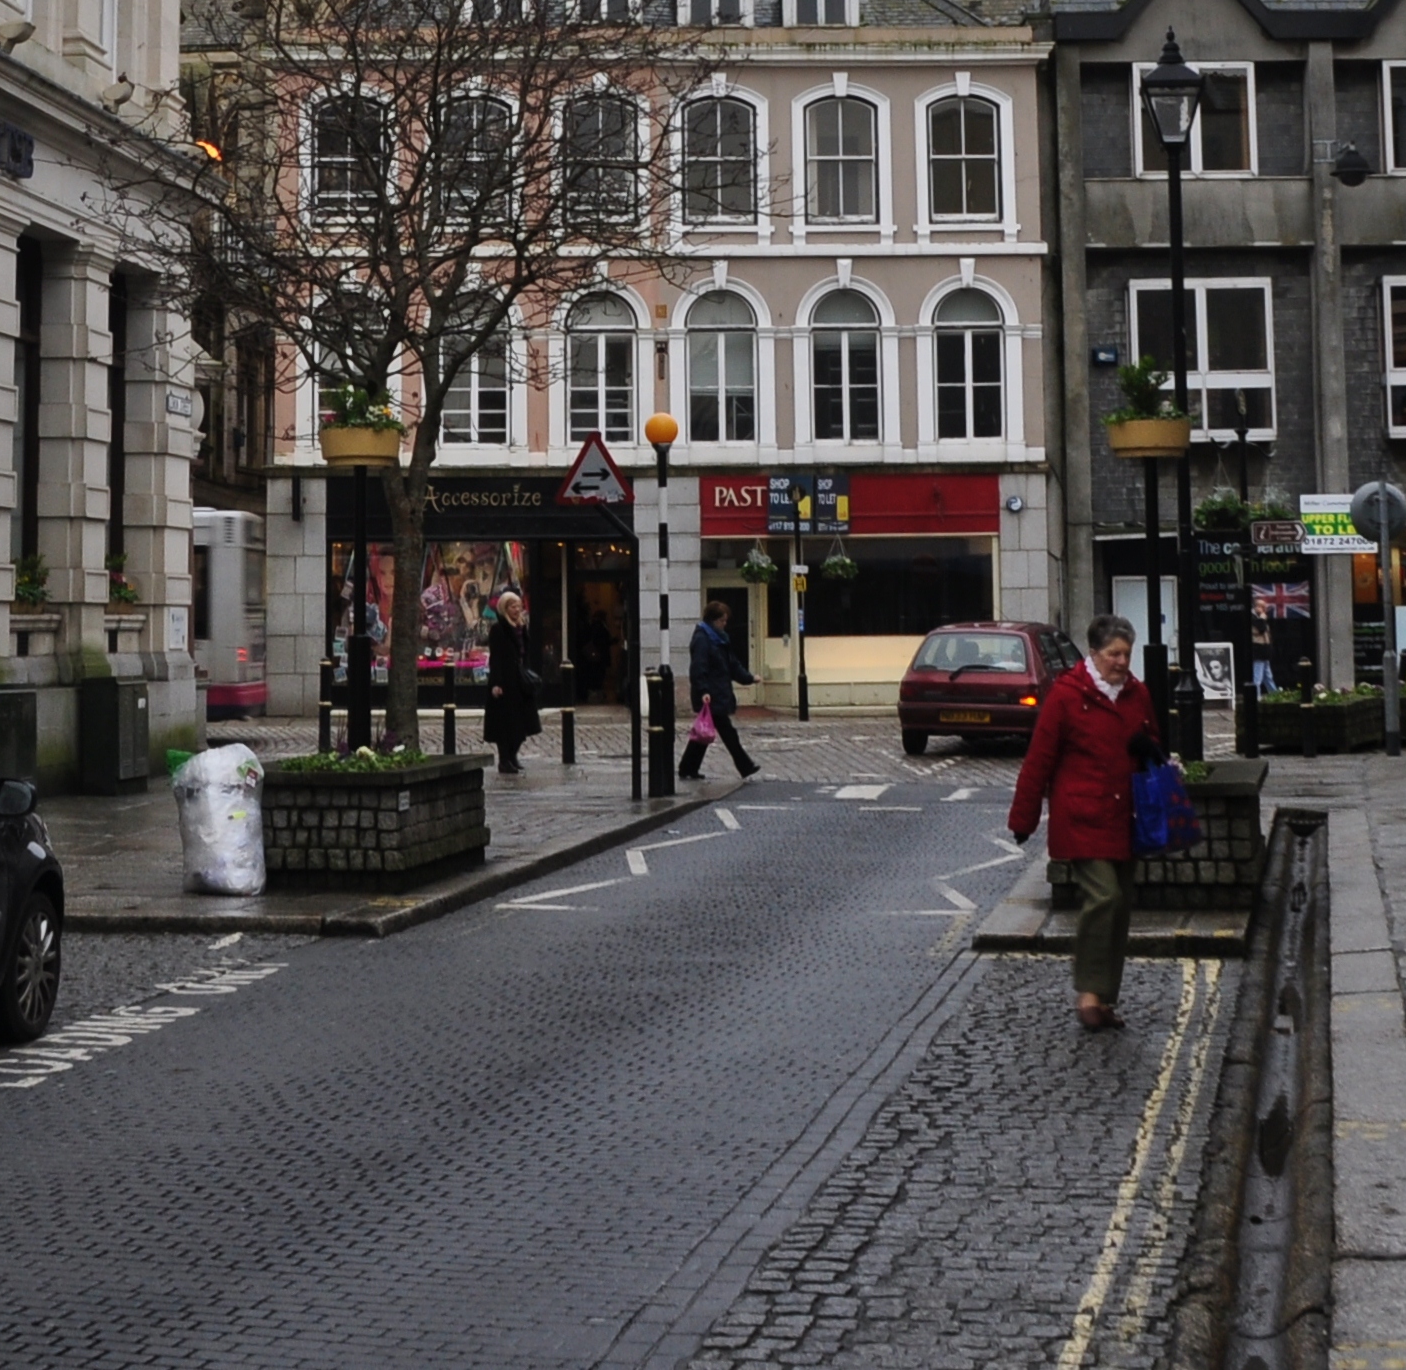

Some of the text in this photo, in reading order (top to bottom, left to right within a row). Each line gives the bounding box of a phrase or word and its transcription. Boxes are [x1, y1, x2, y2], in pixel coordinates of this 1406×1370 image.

[769, 478, 790, 490] SHOP
[817, 478, 833, 490] SHOP
[423, 483, 542, 513] Accessorize
[714, 486, 767, 508] PAST
[769, 493, 793, 504] TO LE
[826, 493, 837, 504] LET
[1302, 514, 1351, 523] UPPER FL
[1313, 525, 1334, 535] TO
[1197, 539, 1221, 555] The
[1199, 558, 1231, 577] good
